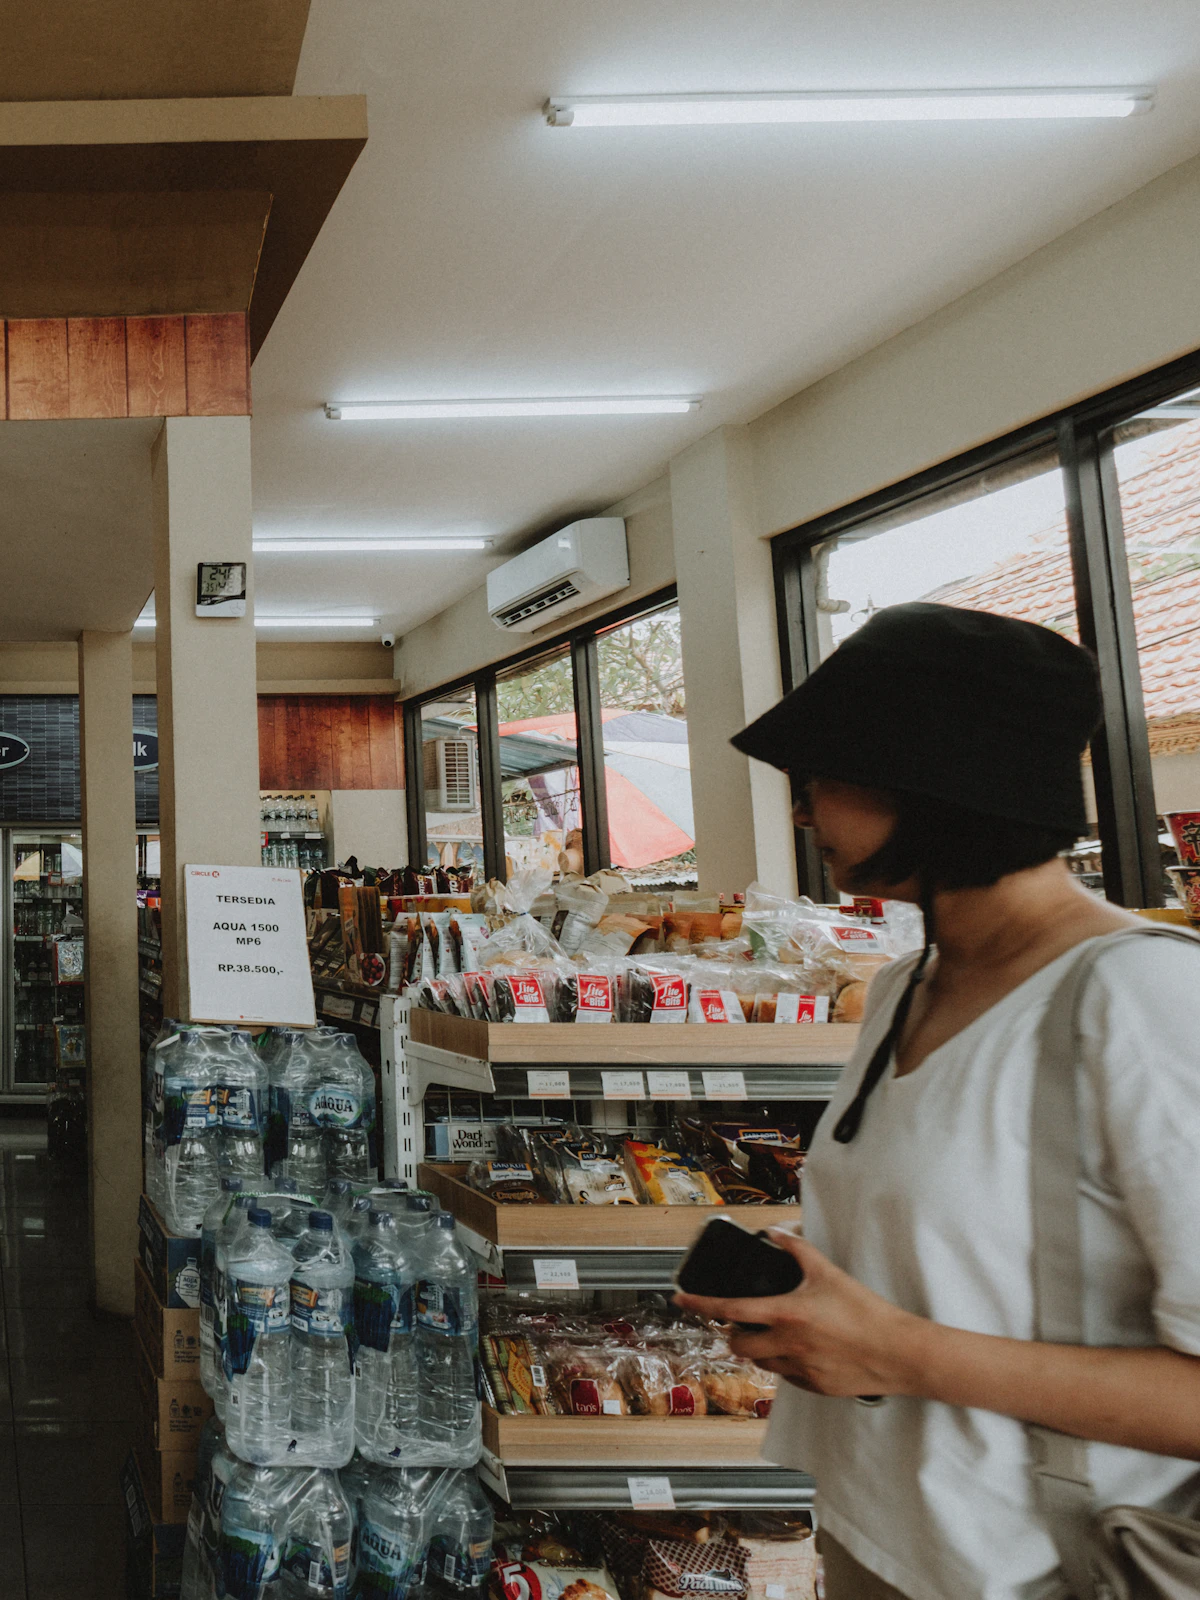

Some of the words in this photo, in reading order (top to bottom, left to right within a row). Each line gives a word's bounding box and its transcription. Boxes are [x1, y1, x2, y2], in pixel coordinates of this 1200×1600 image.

[133, 741, 148, 757] lk
[216, 894, 276, 906] TERSEDIA
[213, 921, 247, 932] AQUA
[250, 923, 280, 933] 1500
[236, 937, 262, 946] MP6
[457, 1129, 483, 1140] Dark
[452, 1139, 494, 1149] Wonder
[576, 1401, 597, 1412] tan's
